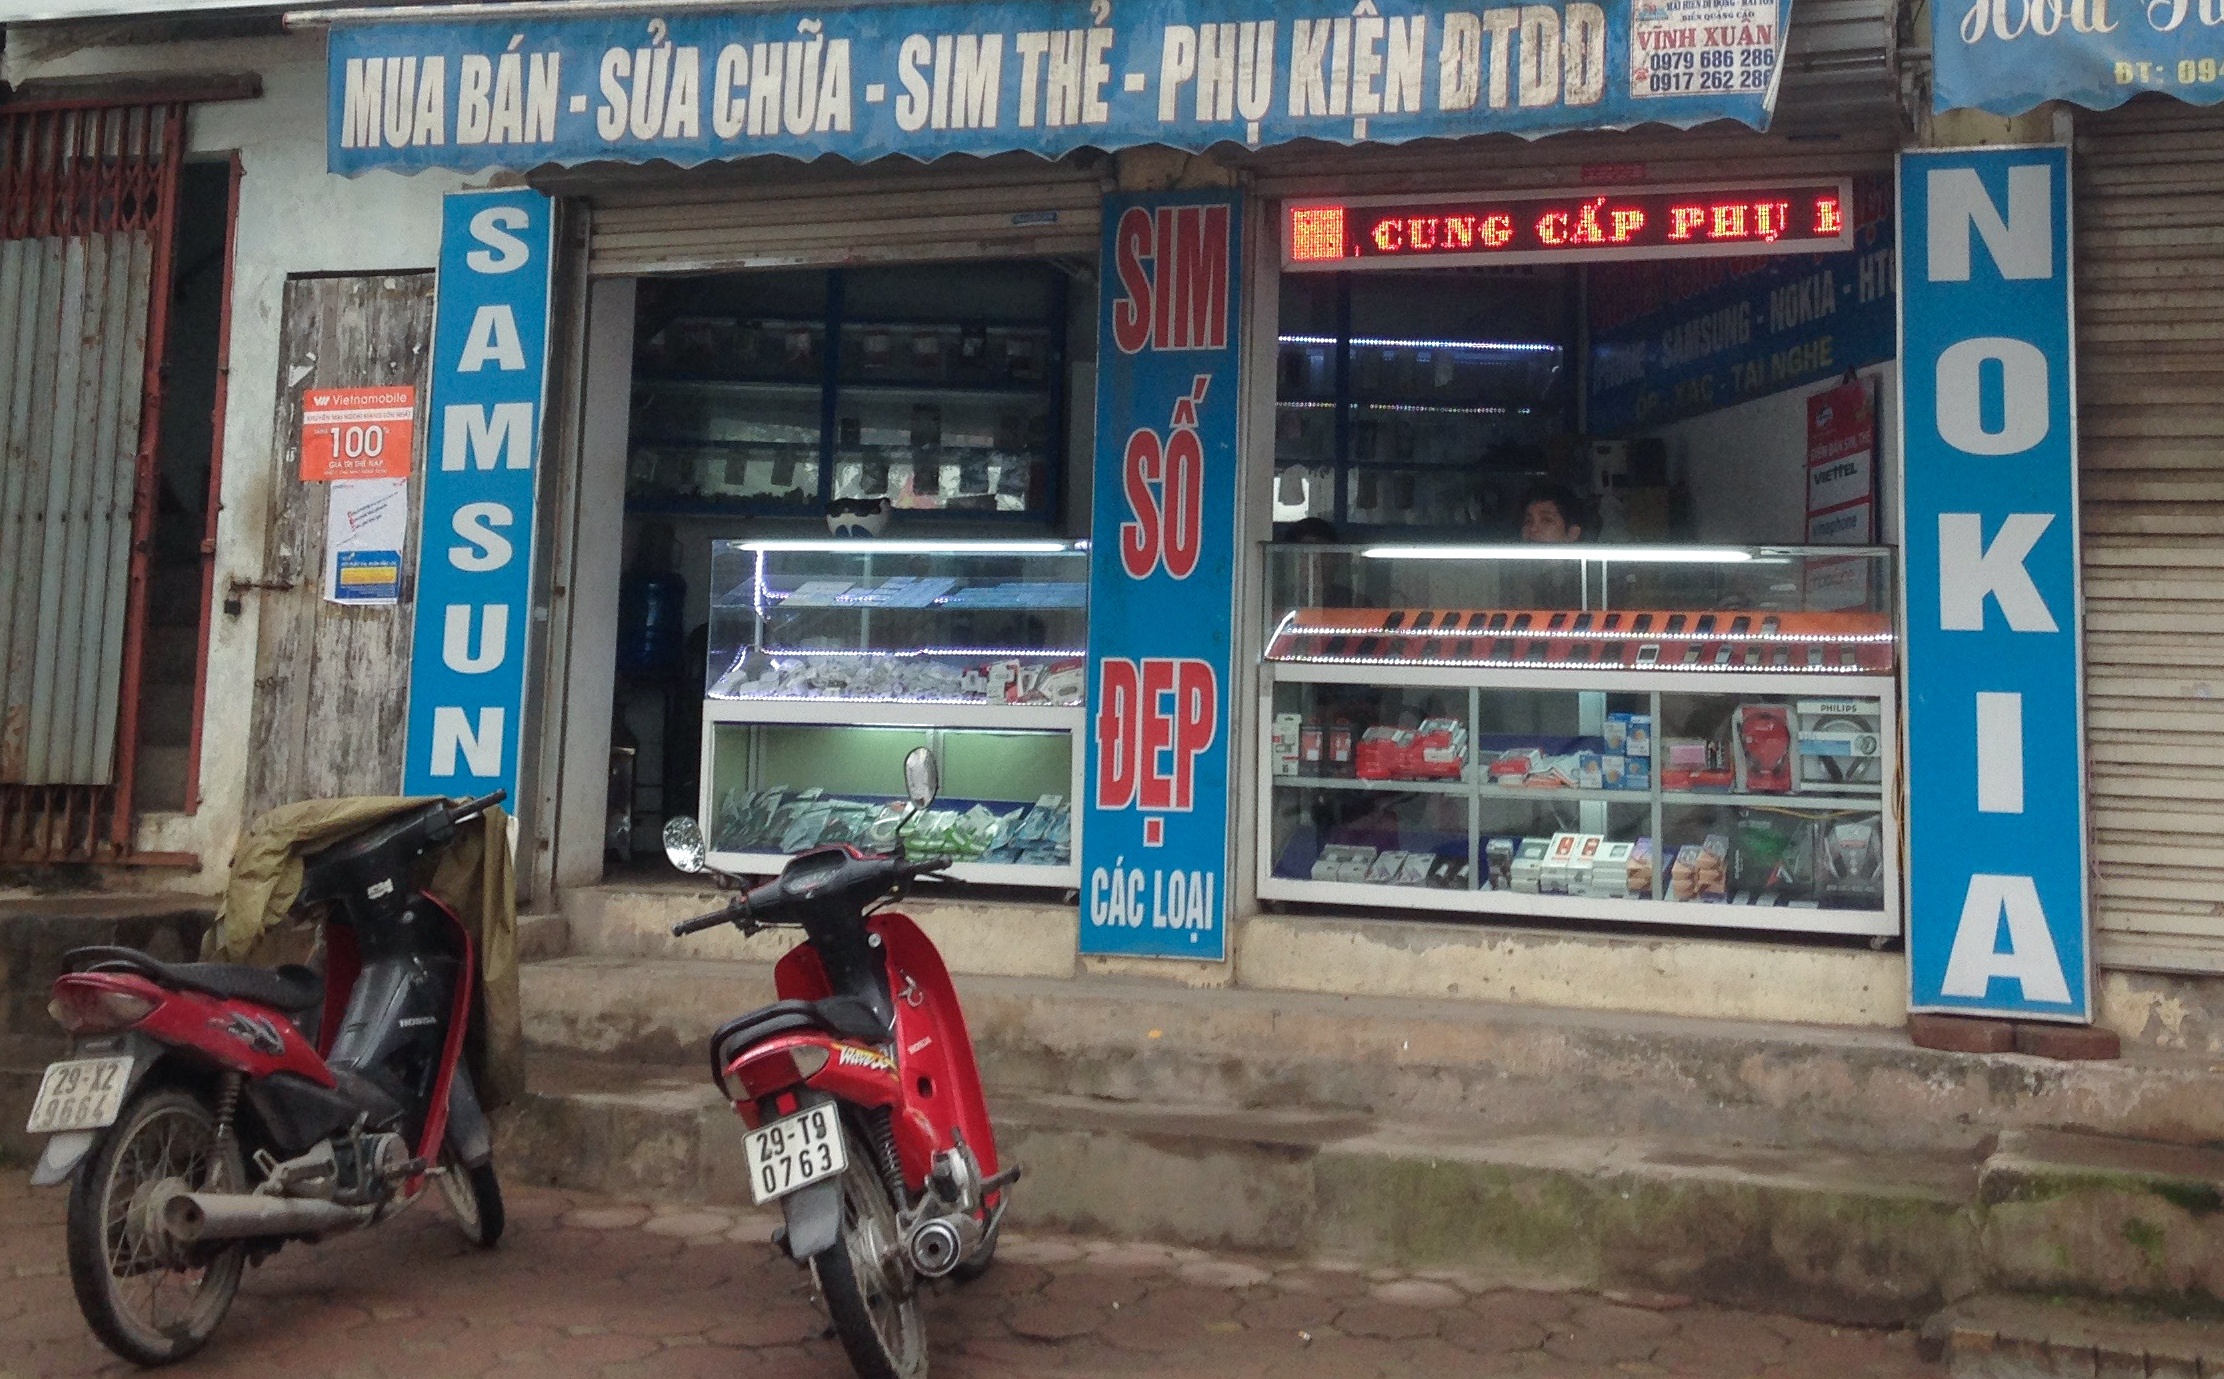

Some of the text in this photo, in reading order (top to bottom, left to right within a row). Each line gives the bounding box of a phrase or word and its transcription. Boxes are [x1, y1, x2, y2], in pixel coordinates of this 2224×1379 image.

[1637, 18, 1772, 51] VĨNH XUÂN
[341, 56, 445, 148] MUA
[456, 34, 560, 144] BÁN
[597, 18, 699, 141] SỬA
[713, 18, 851, 141] CHỮA
[895, 33, 1002, 131] SIM
[1016, 2, 1113, 127] THẺ
[1158, 20, 1275, 145] PHỤ
[1288, 1, 1425, 140] KIỆN
[1651, 48, 1774, 71] 0979 686 286
[1651, 72, 1694, 92] 0917
[1700, 71, 1733, 89] 262
[2177, 57, 2224, 84] 09
[1372, 212, 1513, 250] CUNG
[1112, 203, 1231, 354] SIM
[1770, 270, 1836, 334] NOKIA
[1771, 335, 1833, 382] NGHE
[333, 393, 407, 406] Vietnamobile
[1119, 374, 1212, 580] SỐ
[1813, 462, 1858, 485] VIETTEL
[1926, 165, 2072, 1004] NOKIA
[1820, 704, 1857, 713] PHILIPS
[1096, 657, 1217, 847] ĐẸP
[1090, 855, 1215, 943] CÁC LOẠI
[756, 1111, 827, 1163] 29-T9
[762, 1143, 833, 1194] 0763
